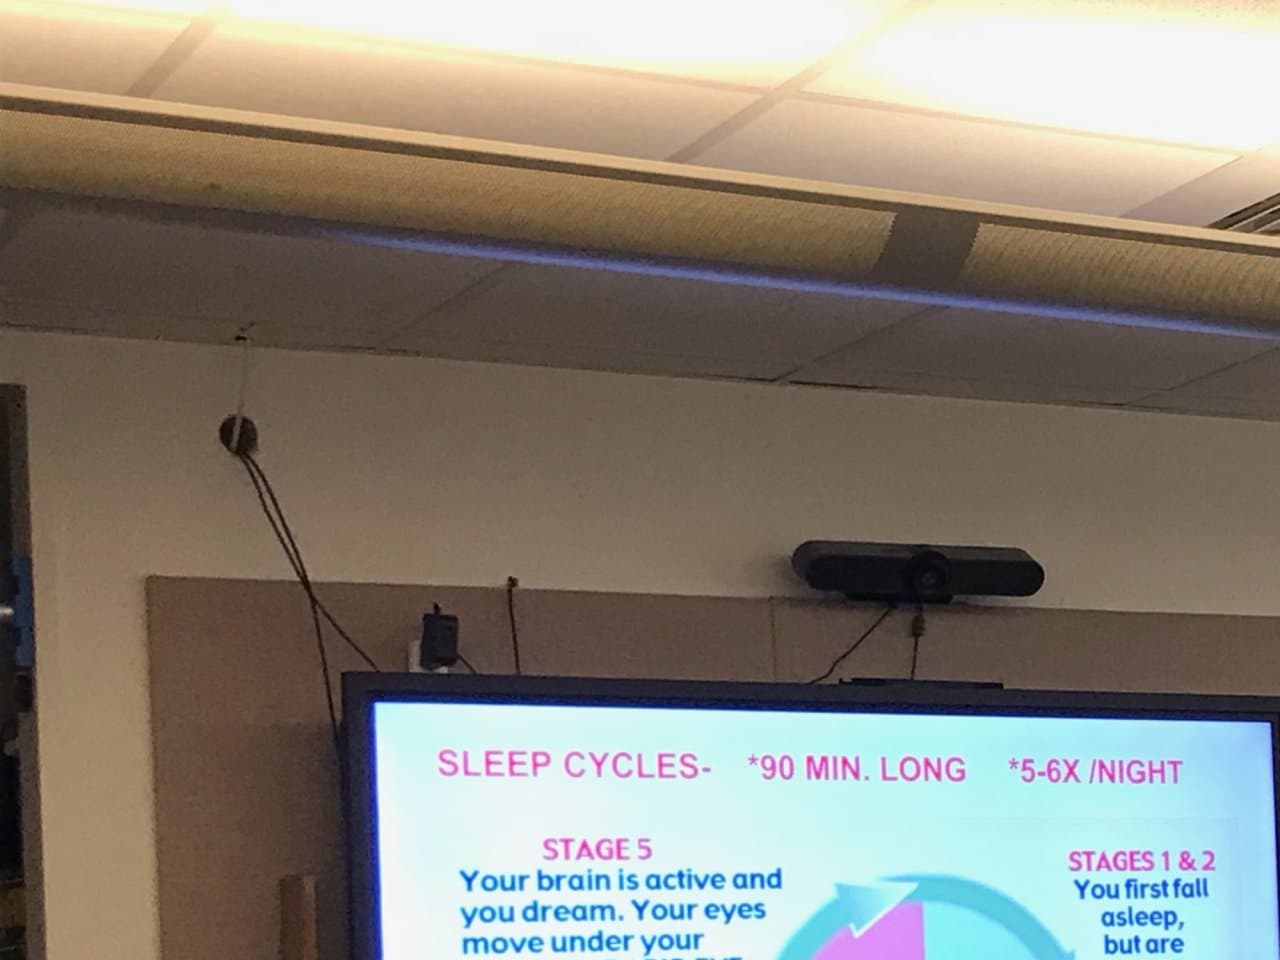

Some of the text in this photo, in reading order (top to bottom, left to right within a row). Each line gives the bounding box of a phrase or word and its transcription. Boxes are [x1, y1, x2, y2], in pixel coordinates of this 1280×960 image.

[438, 749, 551, 777] SLEEP
[564, 751, 711, 779] CYCLES-
[805, 756, 871, 781] MIN.
[880, 756, 967, 781] LONG
[1088, 759, 1183, 784] /NIGHT
[542, 838, 653, 860] STAGE 5
[1068, 850, 1216, 872] STAGES 1 & 2
[459, 867, 783, 892] Your brain is active and
[1073, 877, 1209, 900] You first fall
[460, 900, 767, 928] you dream. Your eyes
[1101, 907, 1185, 931] asleep,
[462, 930, 704, 957] move under your
[1104, 934, 1185, 955] but are
